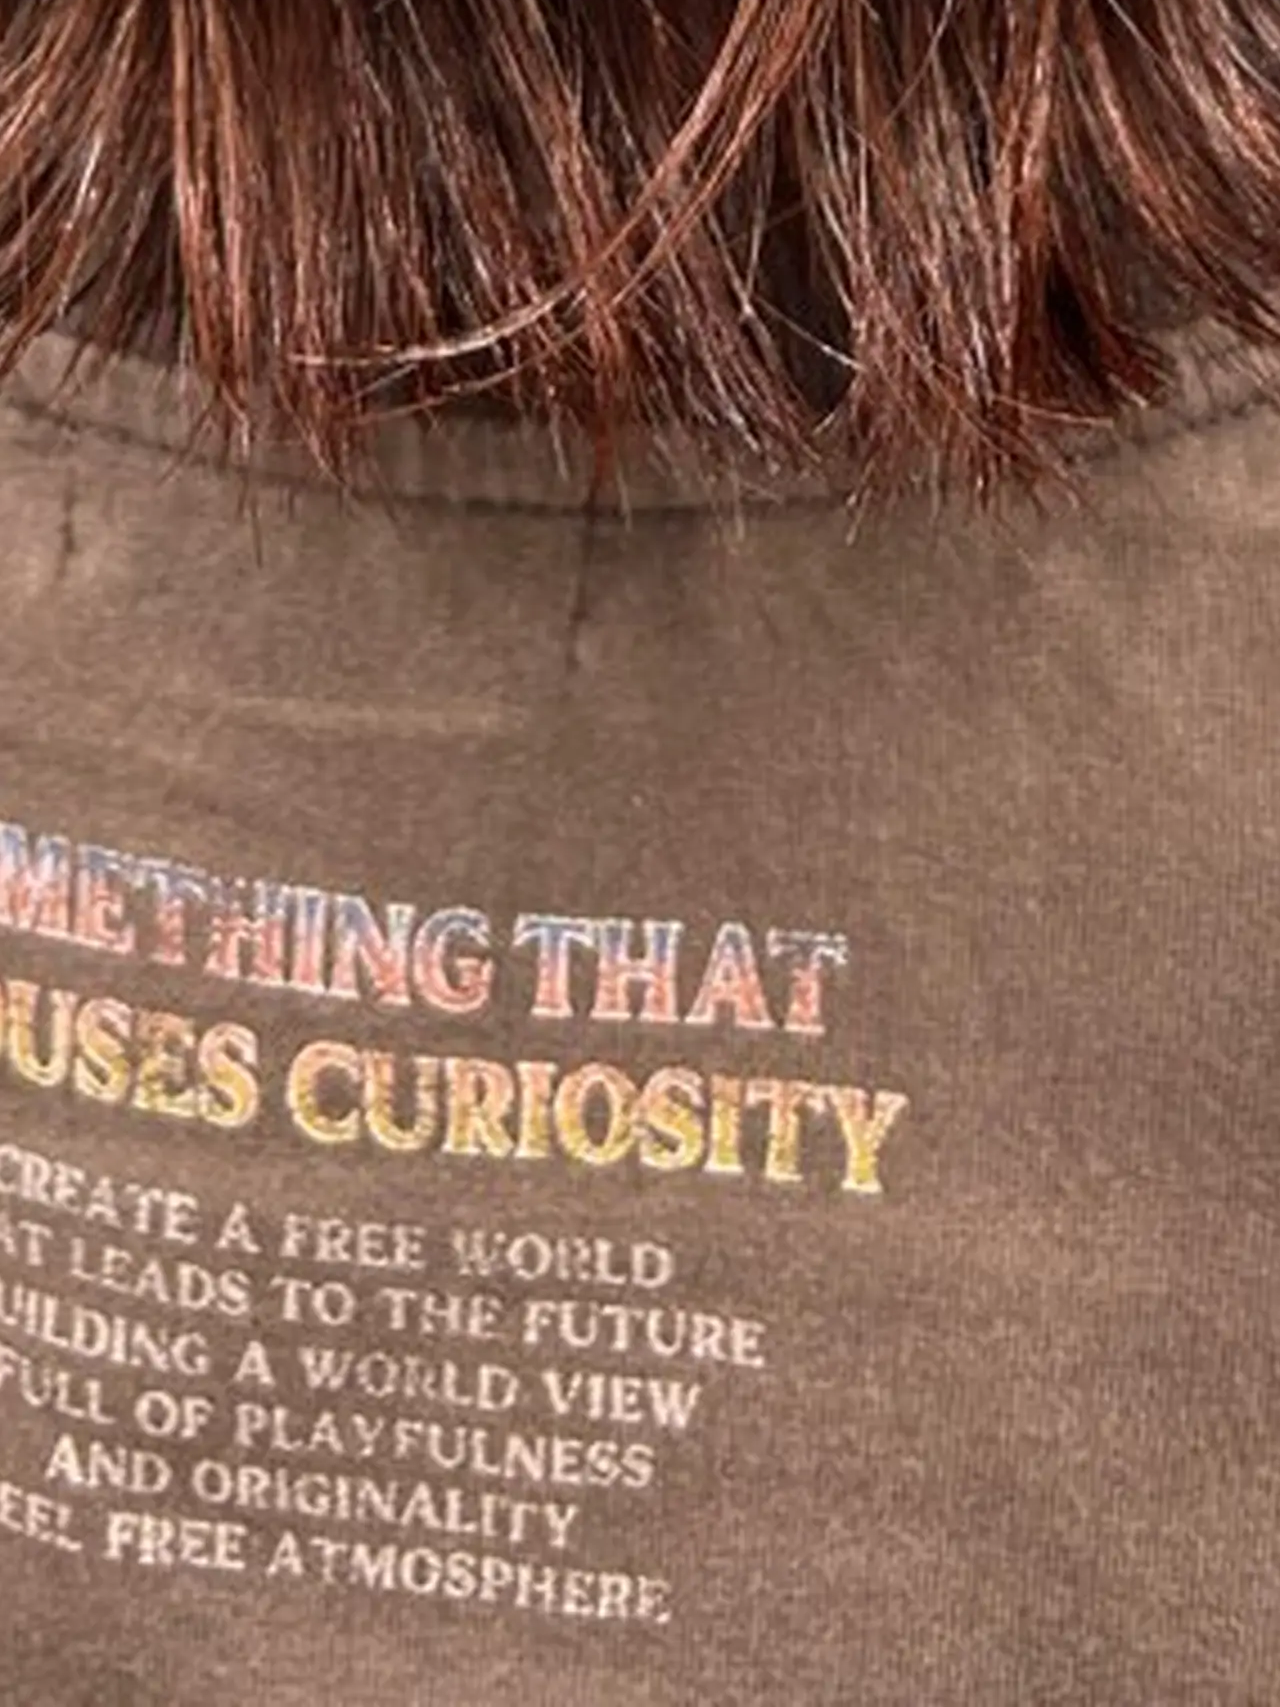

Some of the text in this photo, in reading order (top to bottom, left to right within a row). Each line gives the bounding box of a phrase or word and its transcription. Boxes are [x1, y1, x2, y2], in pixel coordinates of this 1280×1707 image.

[513, 912, 850, 1034] THAT
[286, 1039, 910, 1194] CURIOSITY
[217, 1201, 260, 1254] A
[280, 1213, 426, 1269] FREE
[451, 1227, 673, 1289] WORLD
[70, 1237, 251, 1317] LEADS
[270, 1275, 356, 1327] TO
[382, 1287, 505, 1339] THE
[523, 1299, 766, 1368] FUTURE
[134, 1390, 215, 1439] OF
[234, 1402, 656, 1488] PLAYFULNESS
[234, 1340, 276, 1387] A
[298, 1345, 519, 1412] WORLD
[541, 1370, 702, 1430] VIEW
[45, 1433, 579, 1549] AND ORIGINALITY
[103, 1511, 248, 1571] FREE
[266, 1530, 673, 1624] ATMOSPHERE
